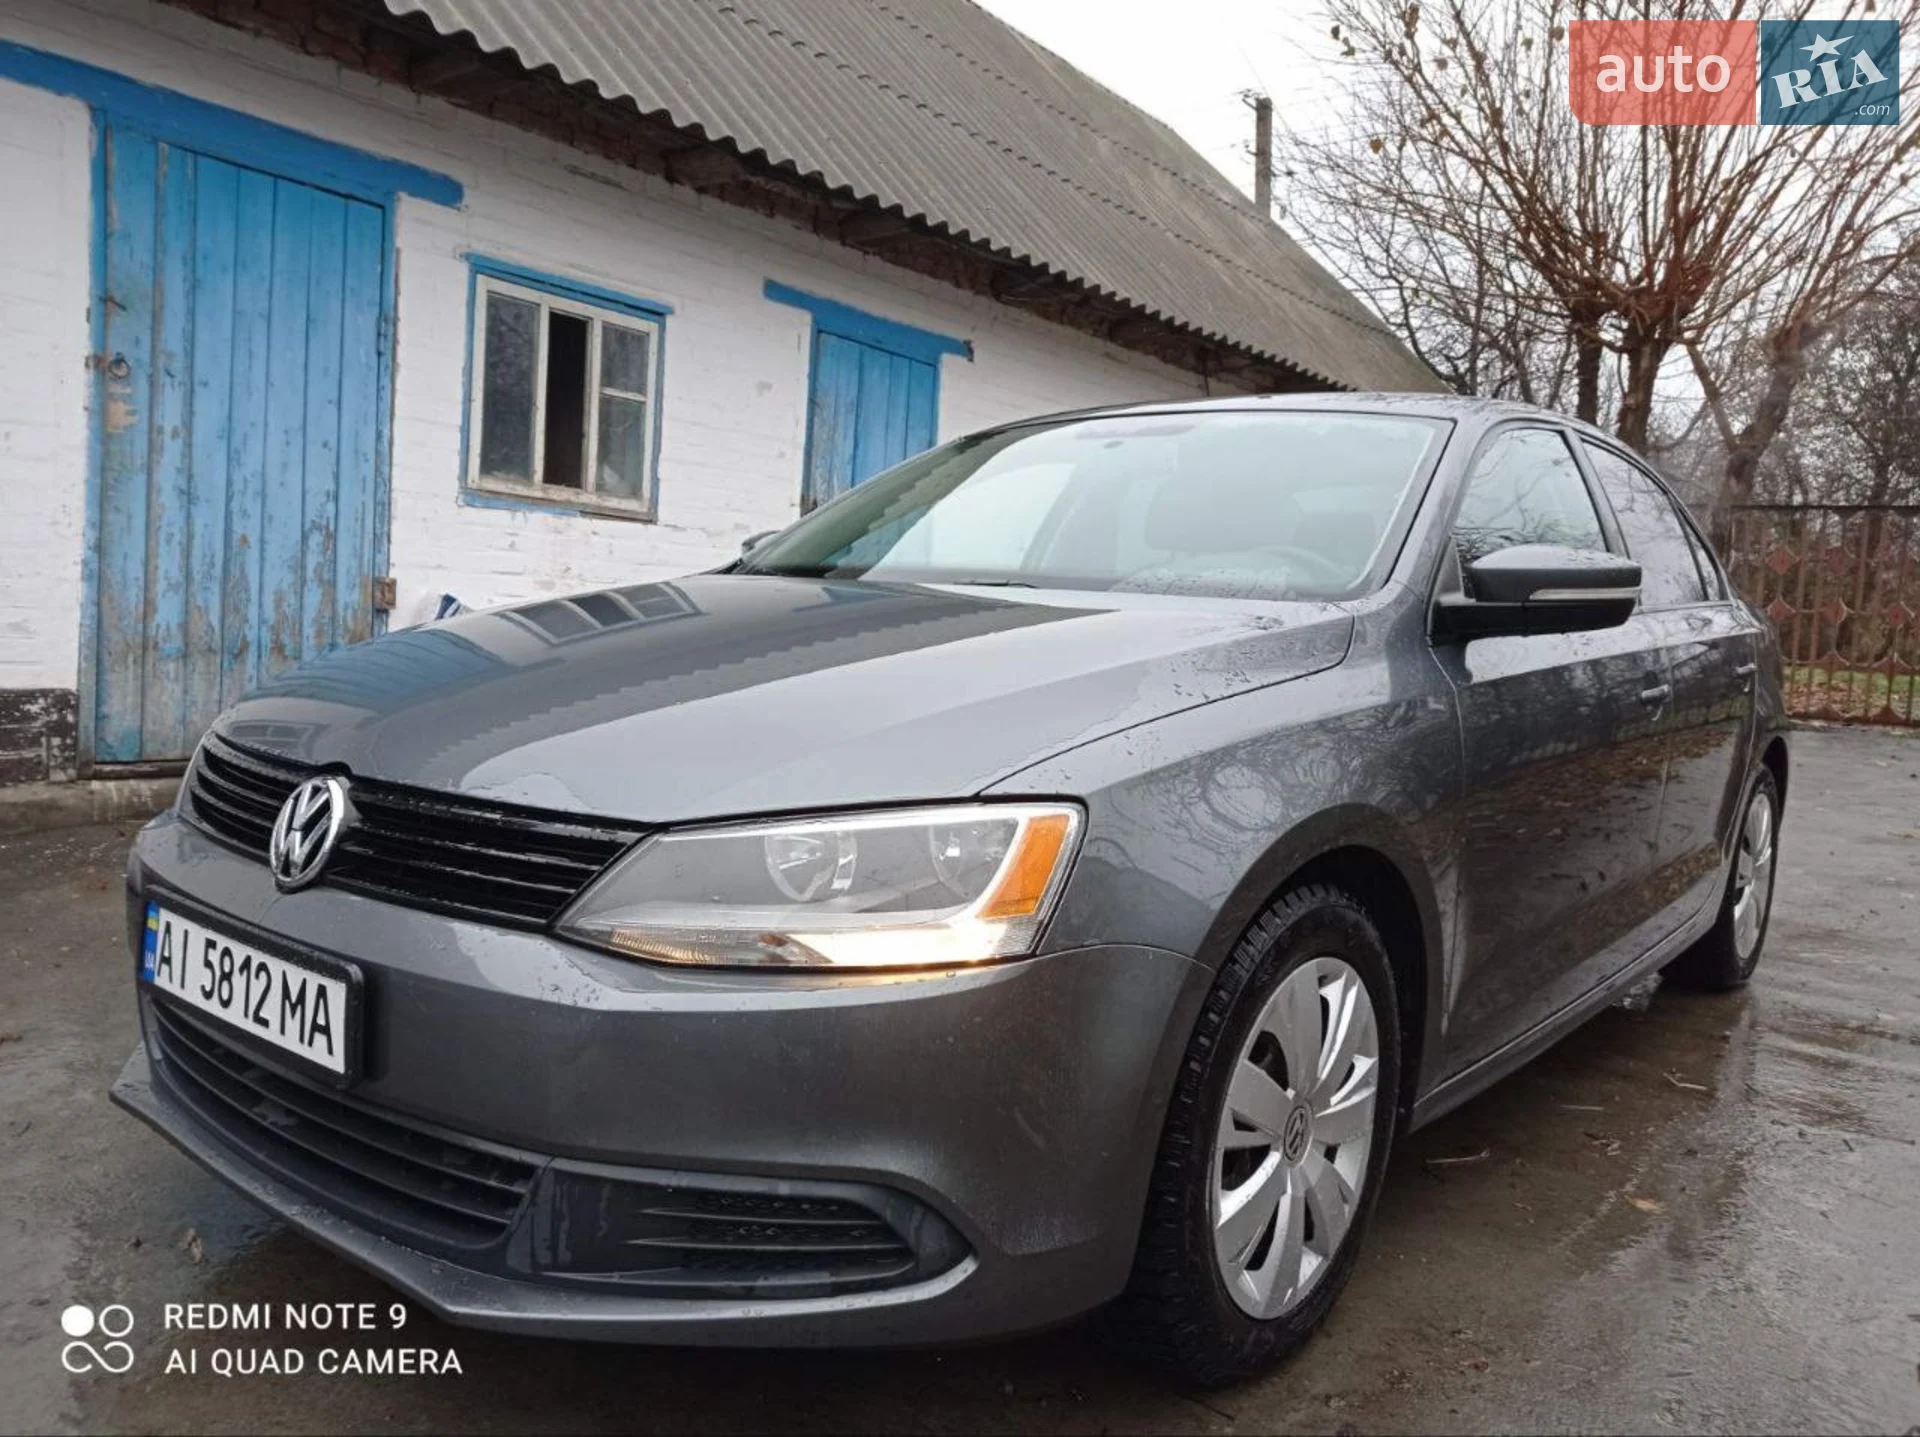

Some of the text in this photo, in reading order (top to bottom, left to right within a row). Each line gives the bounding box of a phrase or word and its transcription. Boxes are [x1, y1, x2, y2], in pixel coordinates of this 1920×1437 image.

[157, 920, 334, 1057] AI 5812 MA
